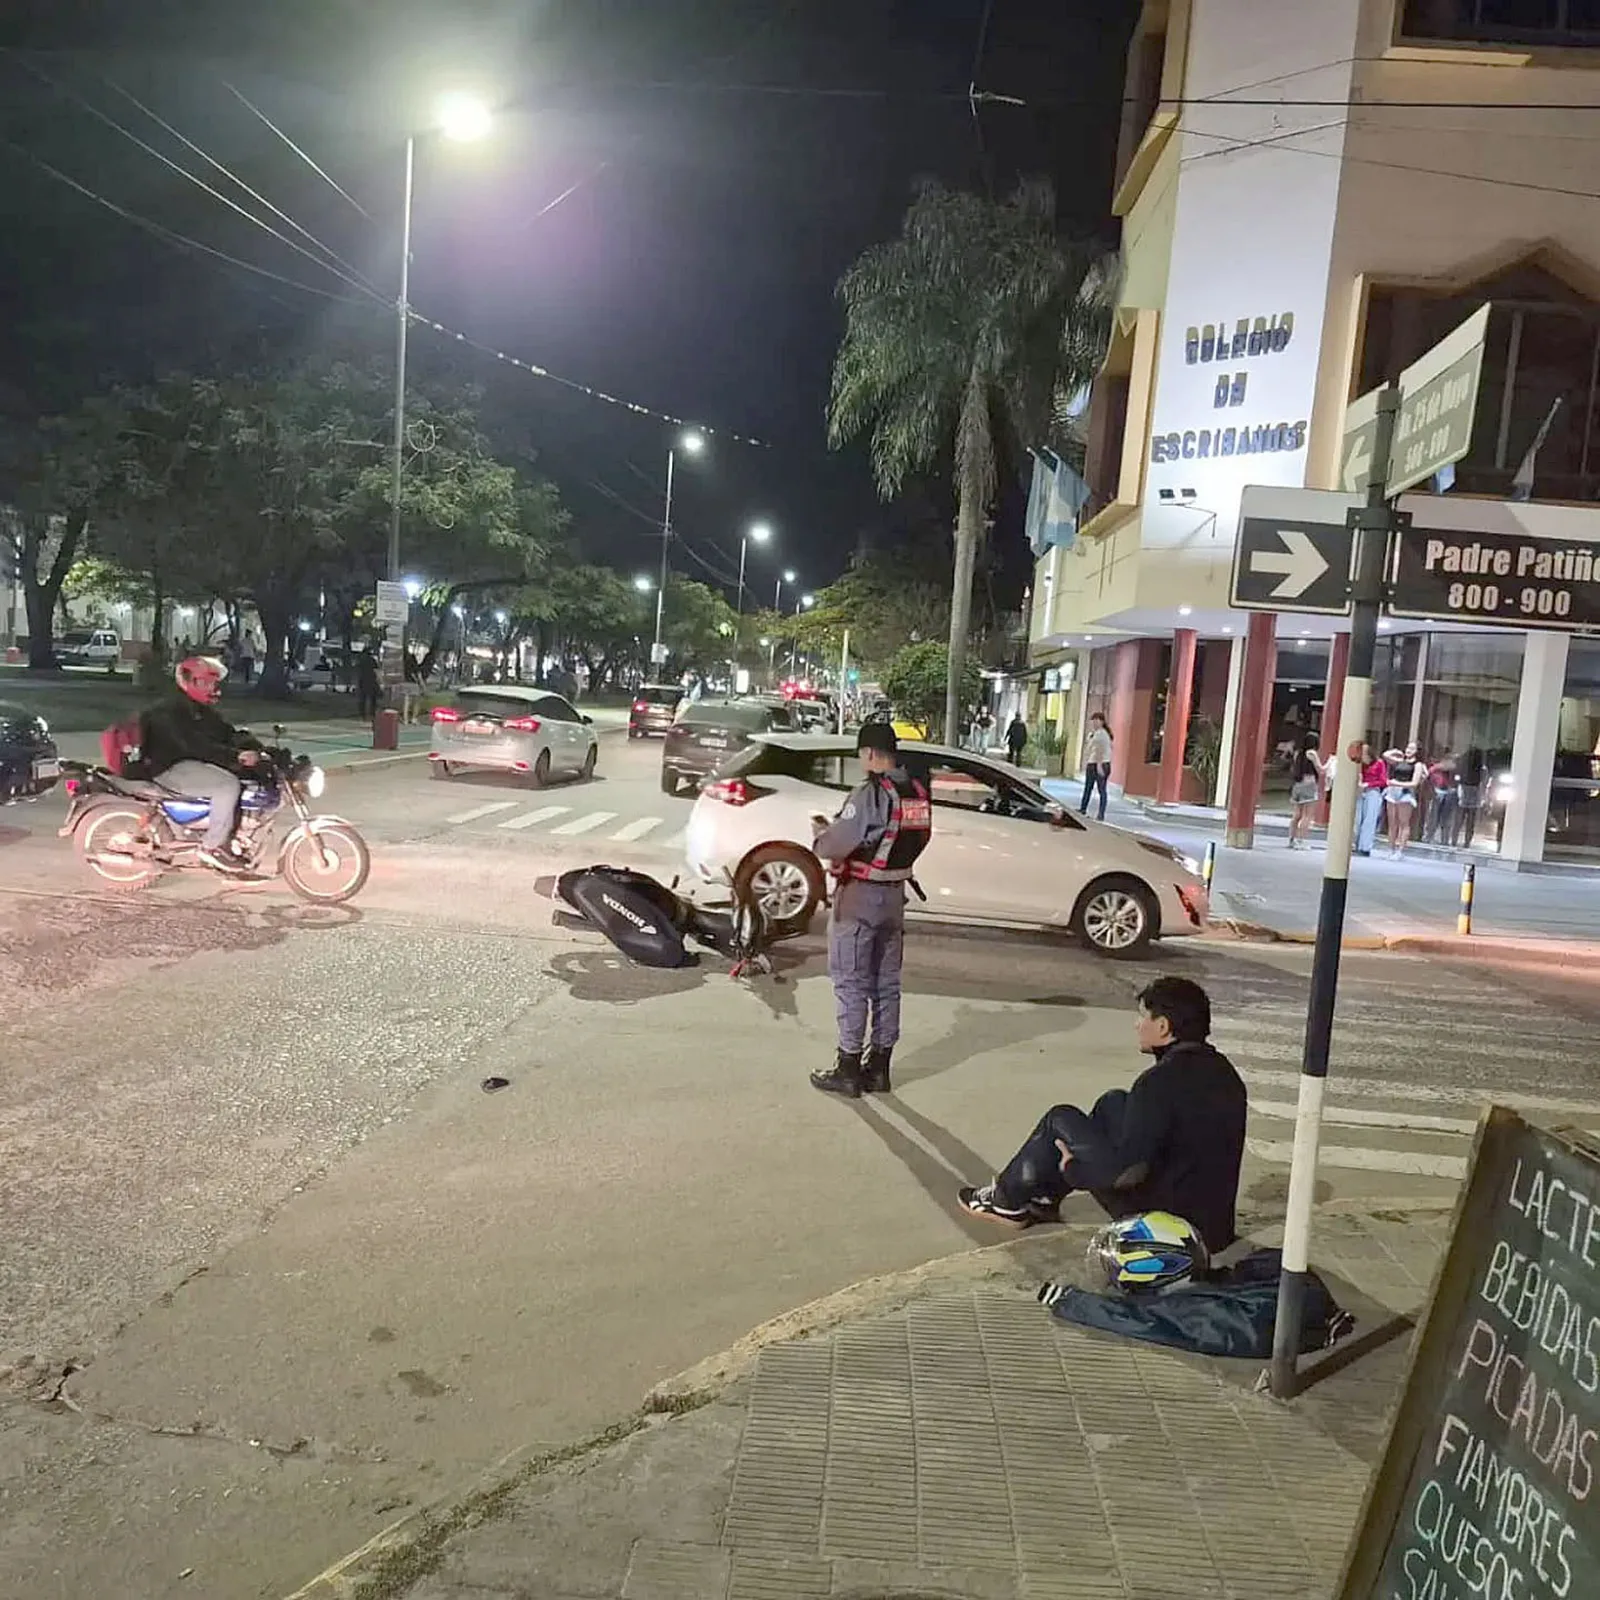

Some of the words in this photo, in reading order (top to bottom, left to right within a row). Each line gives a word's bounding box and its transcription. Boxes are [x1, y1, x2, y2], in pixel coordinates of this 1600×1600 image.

[1186, 311, 1294, 365] COLEGIO
[1213, 371, 1248, 409] DE
[1151, 420, 1307, 463] ESCRIBANOS
[1425, 539, 1511, 576] Padre
[1448, 582, 1499, 611] 800
[1520, 587, 1571, 616] 900
[602, 893, 646, 928] HONDA
[1436, 1413, 1577, 1597] FIAMBRES
